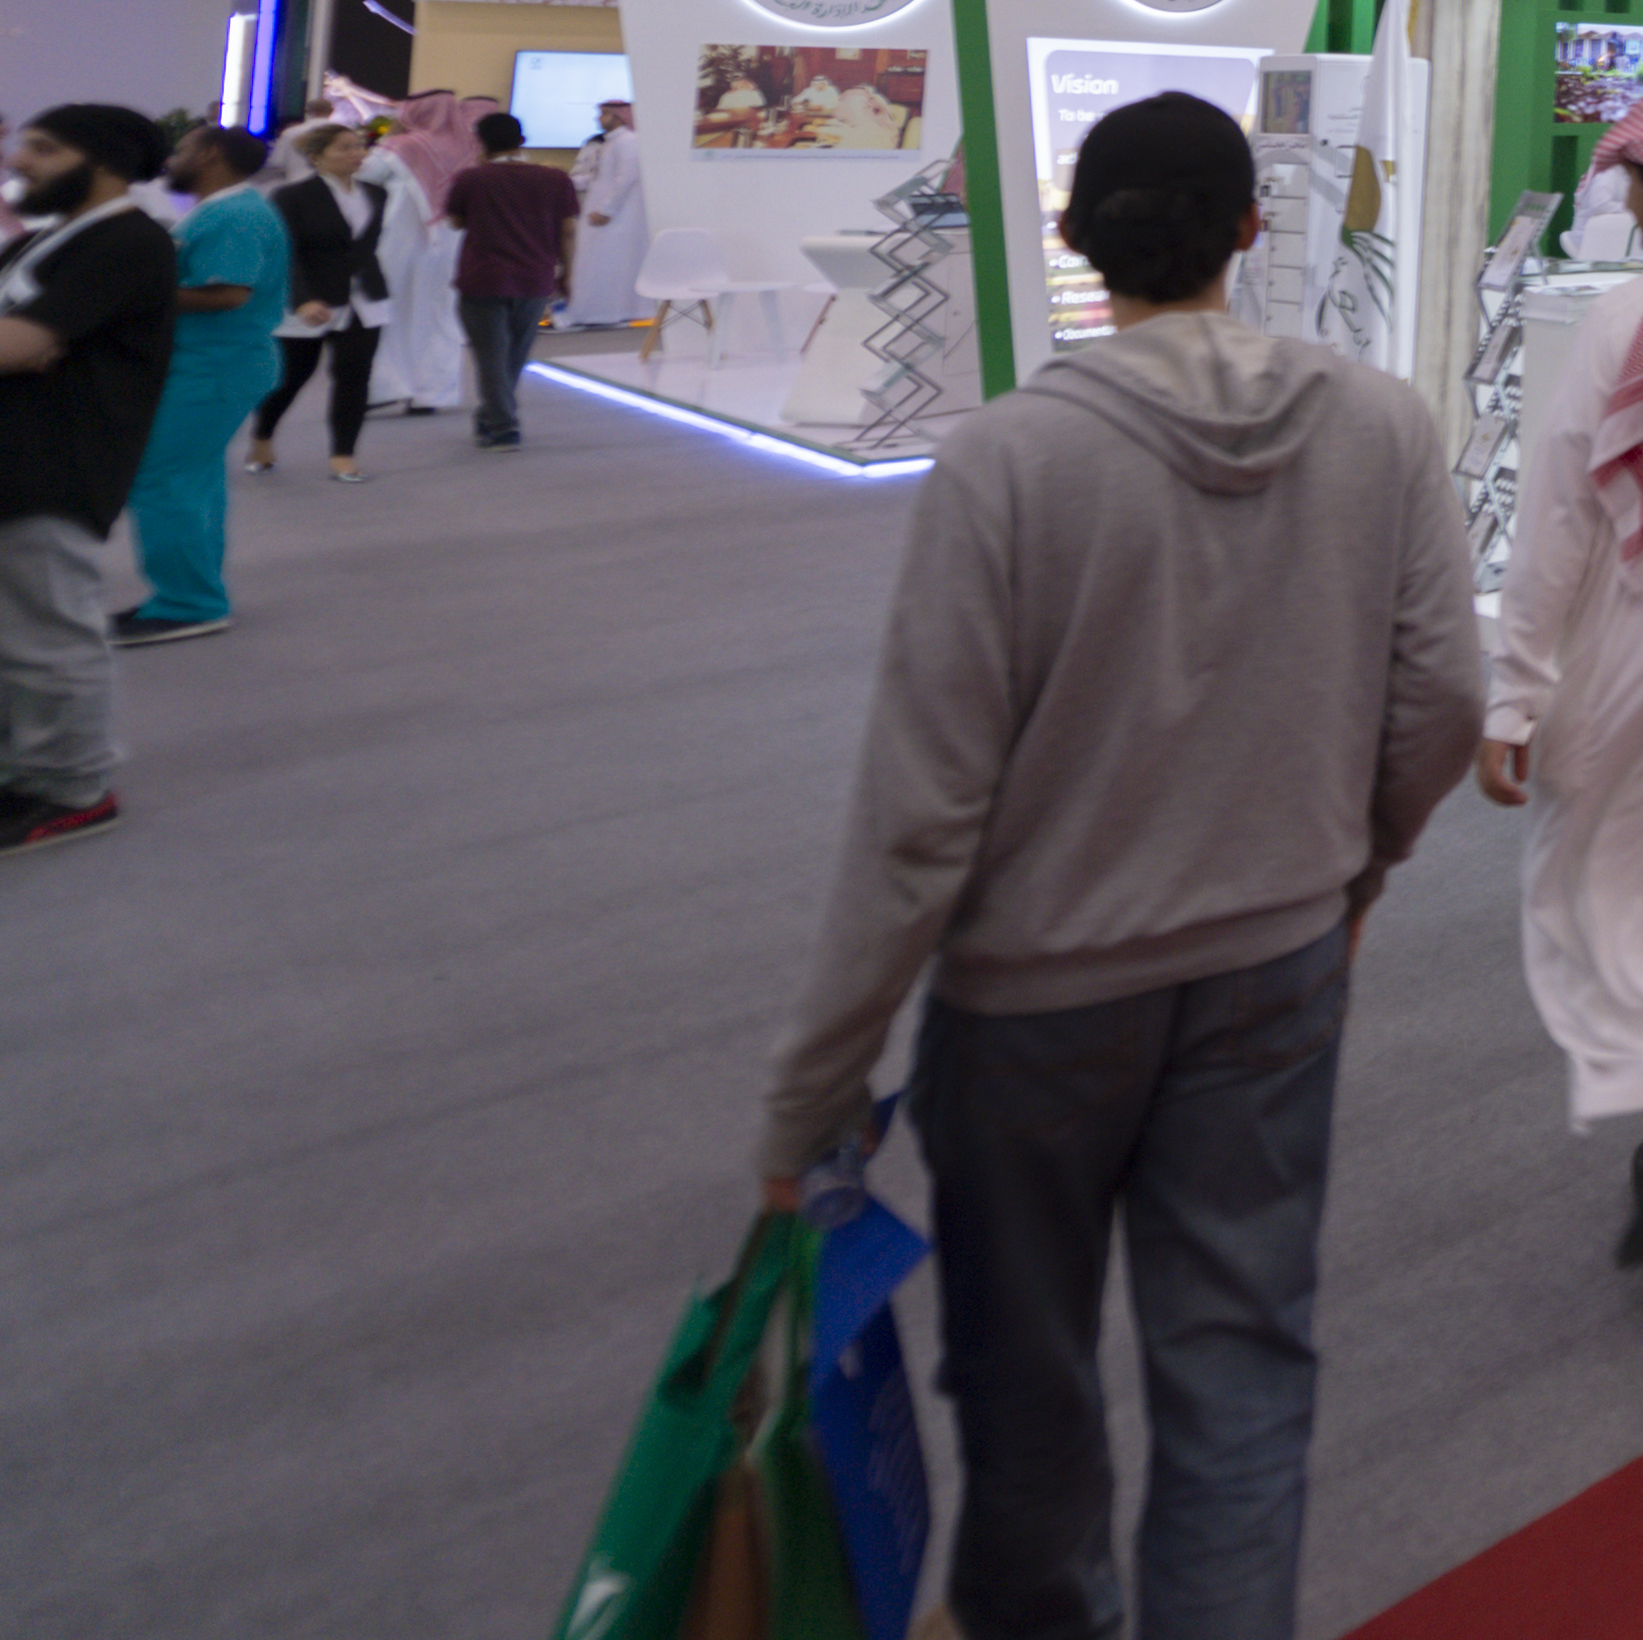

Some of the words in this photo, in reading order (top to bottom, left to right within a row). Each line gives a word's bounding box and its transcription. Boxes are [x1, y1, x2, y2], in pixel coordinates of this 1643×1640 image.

[1051, 73, 1119, 95] Vision
[1058, 109, 1075, 122] To
[1061, 290, 1110, 304] Resea
